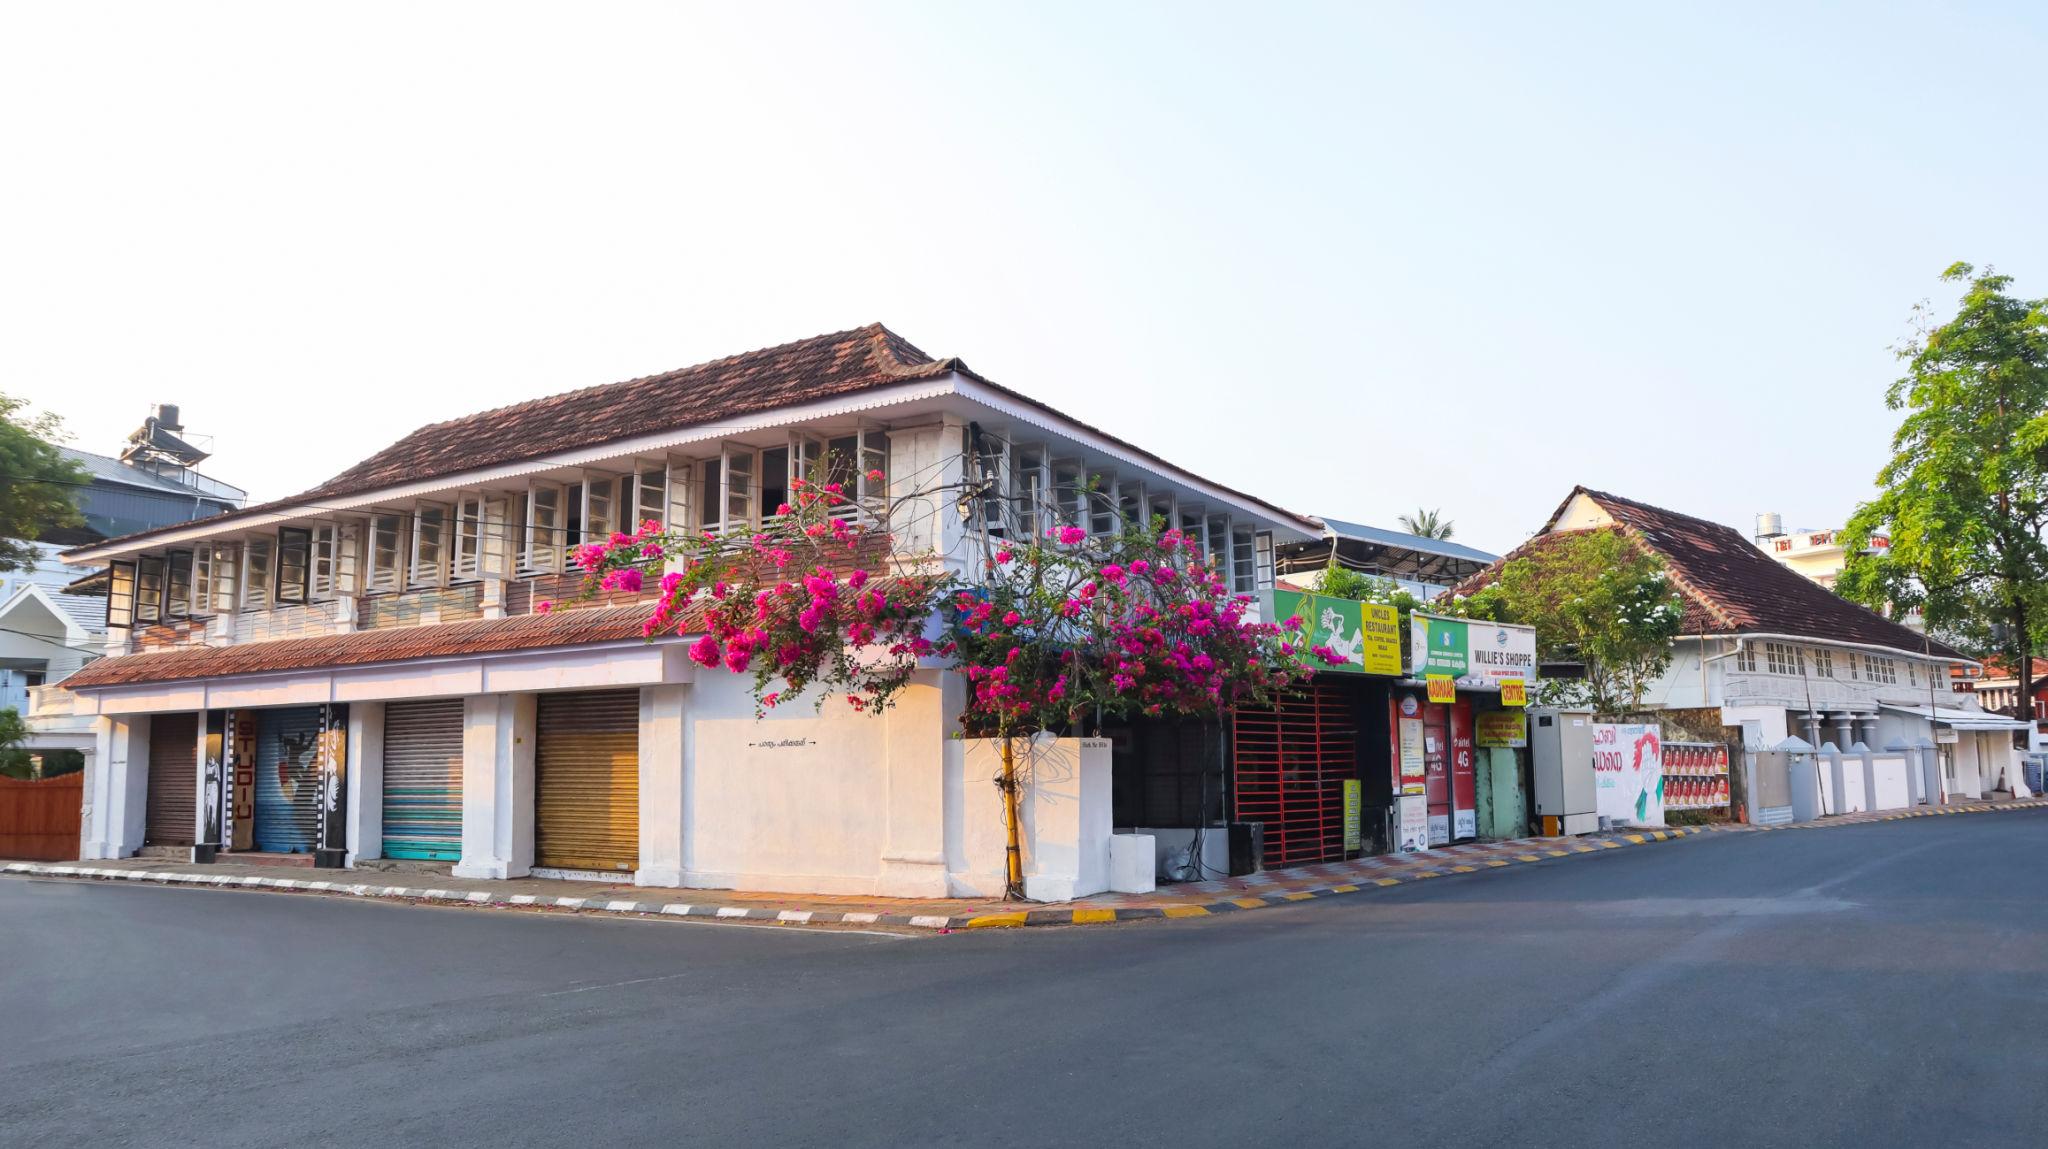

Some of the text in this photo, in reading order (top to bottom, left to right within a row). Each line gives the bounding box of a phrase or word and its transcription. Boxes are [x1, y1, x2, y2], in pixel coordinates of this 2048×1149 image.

[1366, 621, 1396, 635] RESTAURANT
[1475, 650, 1504, 665] WILLIE'S
[1506, 652, 1531, 667] SHOPPE
[1503, 685, 1523, 700] CENTRE
[1459, 738, 1470, 747] airtel
[1431, 754, 1442, 771] 4G
[1458, 751, 1469, 767] 4G
